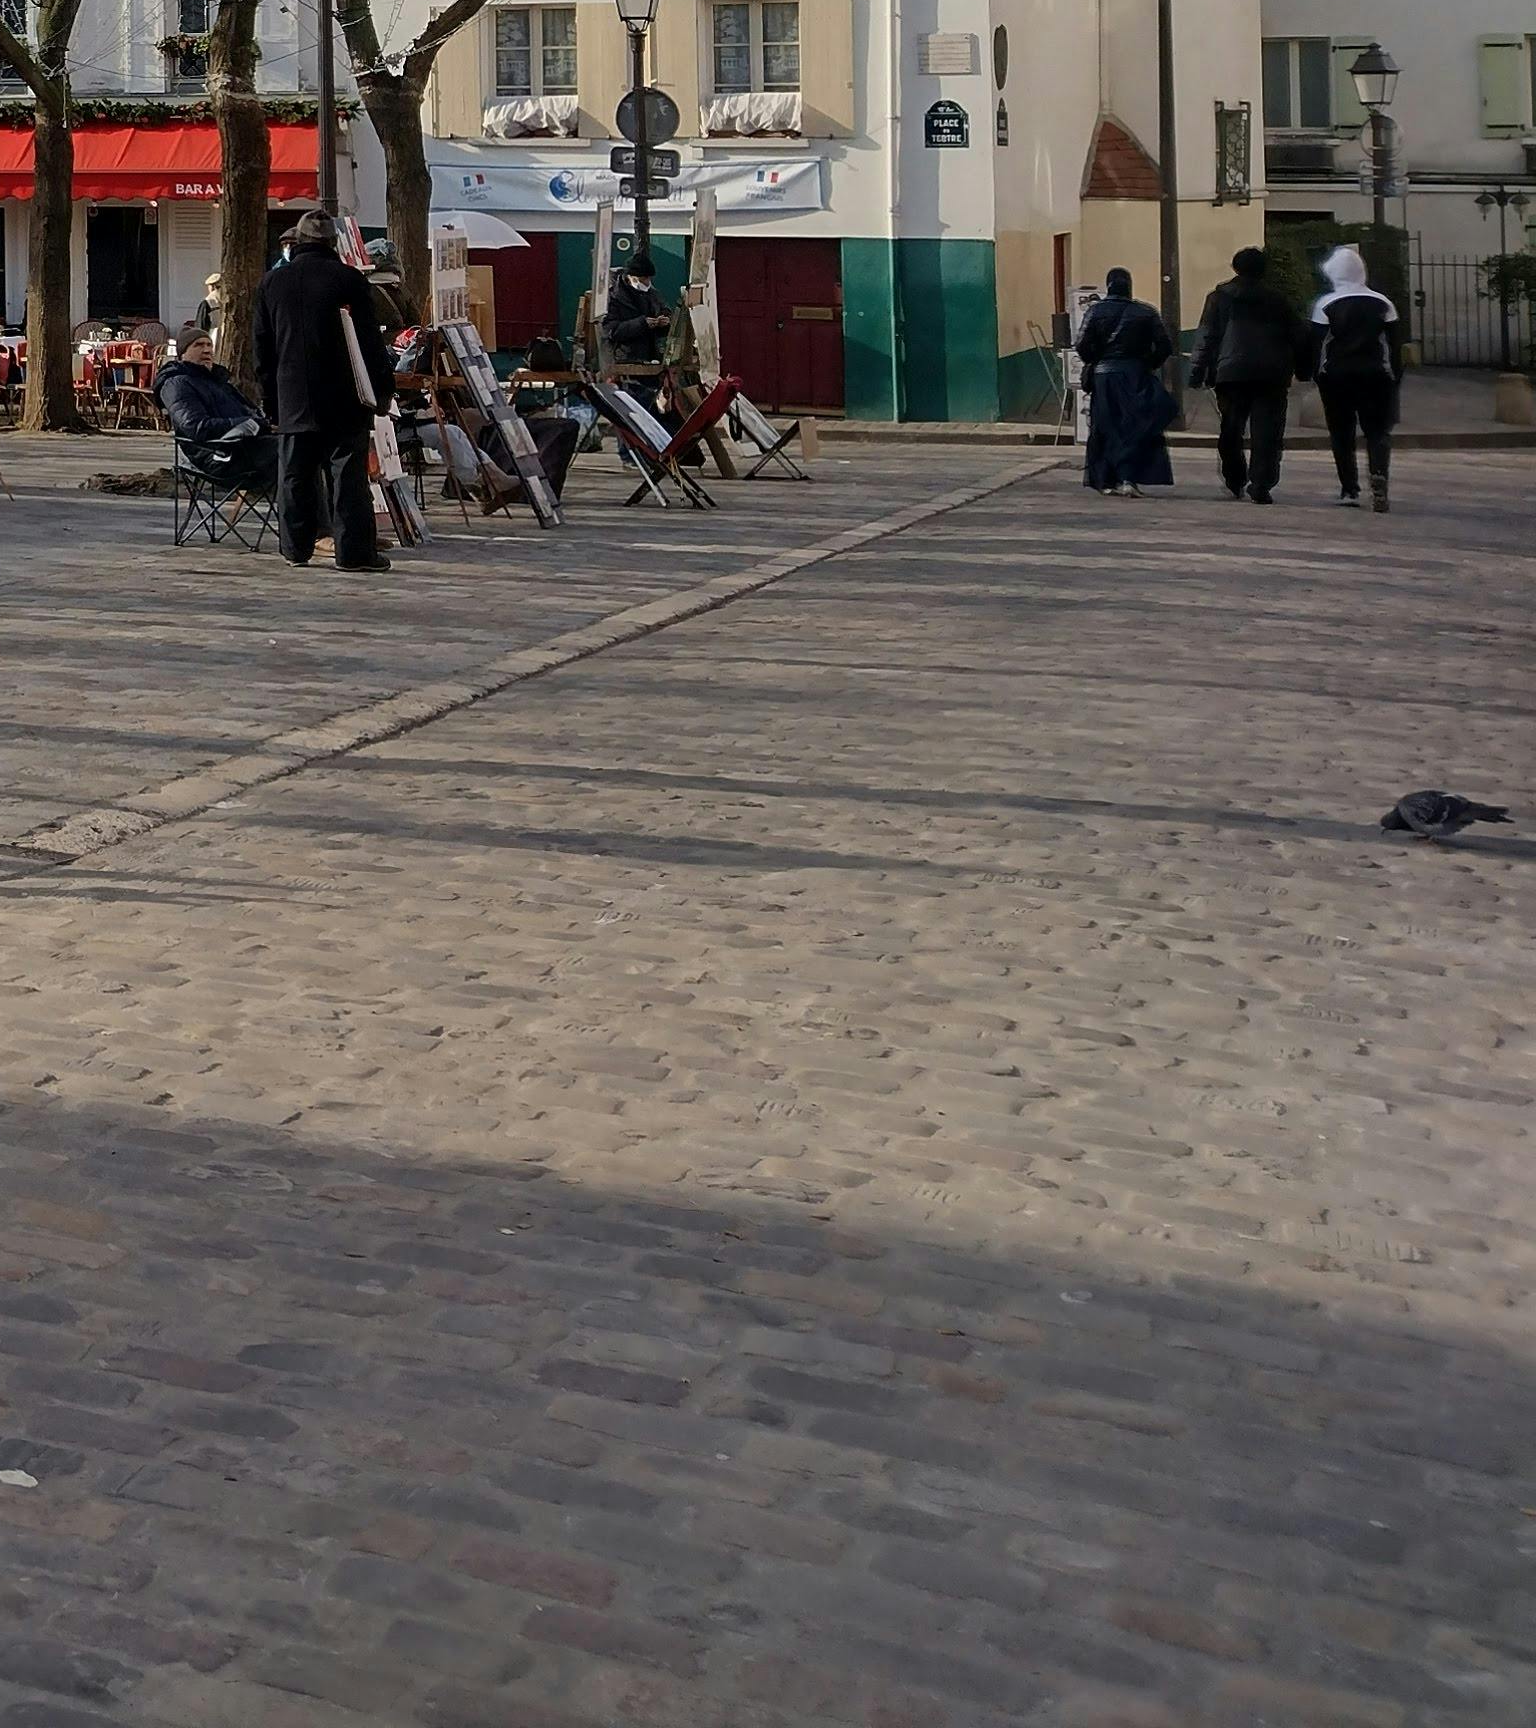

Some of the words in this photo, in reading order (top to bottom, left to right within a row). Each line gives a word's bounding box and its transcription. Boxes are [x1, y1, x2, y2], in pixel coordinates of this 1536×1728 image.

[933, 119, 959, 128] PLACE
[931, 134, 962, 143] TERTRE
[175, 183, 203, 195] BAR
